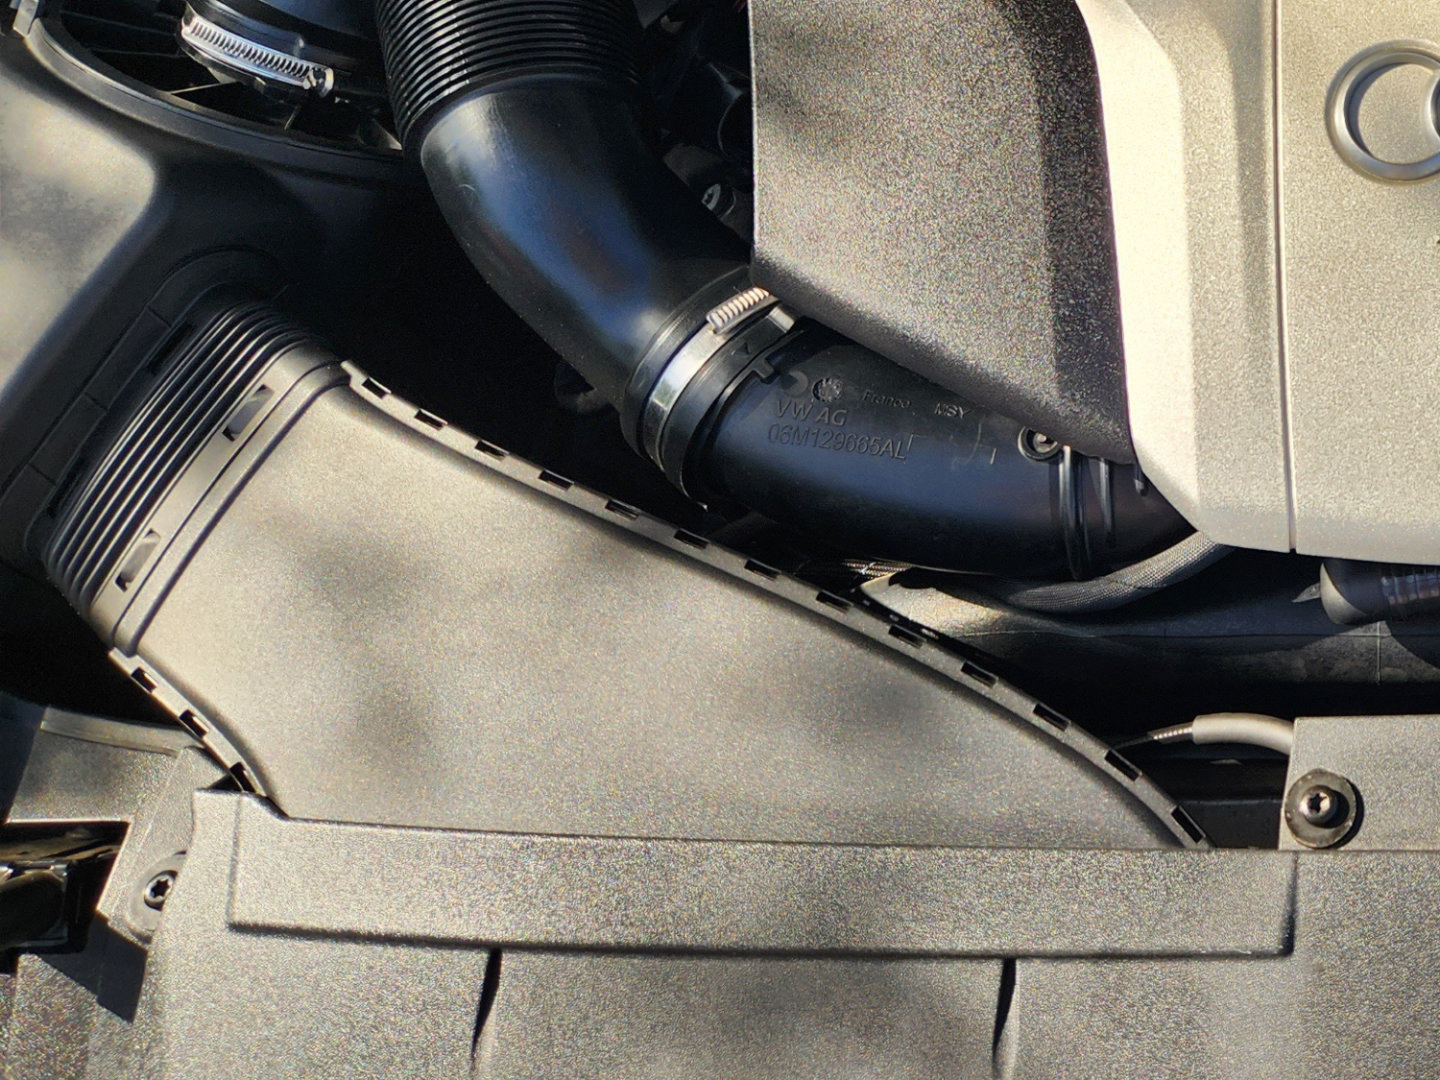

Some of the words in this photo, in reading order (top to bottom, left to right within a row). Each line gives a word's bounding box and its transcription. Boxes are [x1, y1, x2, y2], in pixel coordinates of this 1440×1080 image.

[776, 399, 813, 419] VW
[816, 406, 848, 426] AG
[768, 422, 907, 460] 06M129665AL
